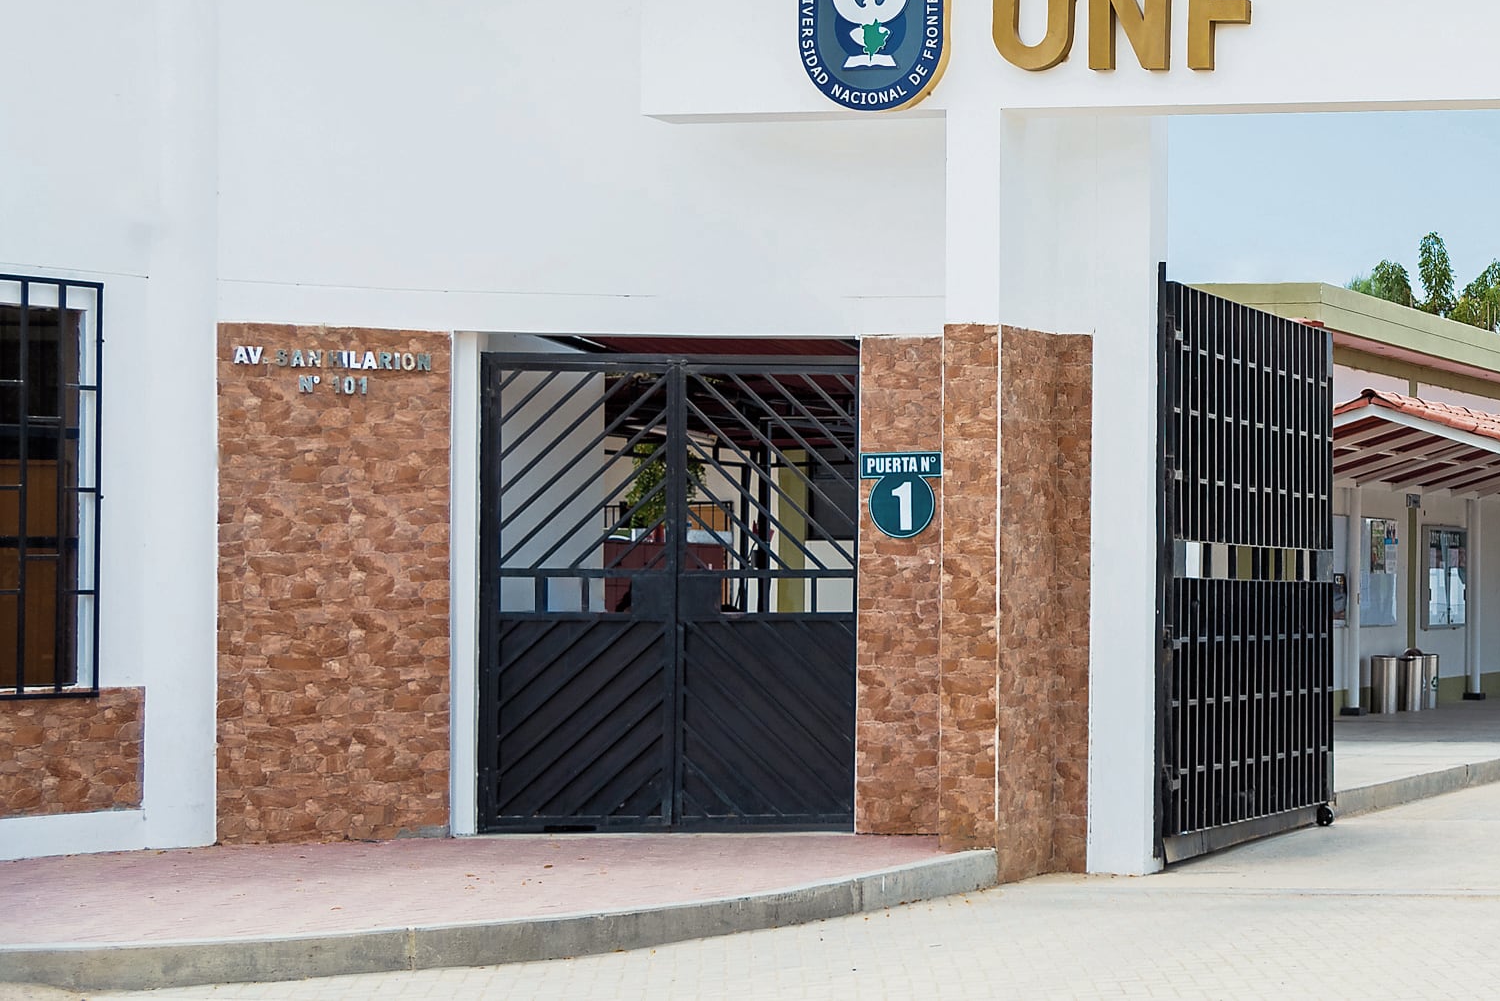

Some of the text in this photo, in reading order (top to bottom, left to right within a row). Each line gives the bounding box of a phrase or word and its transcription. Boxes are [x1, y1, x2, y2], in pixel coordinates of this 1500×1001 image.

[830, 84, 908, 105] NACIONAL
[908, 64, 928, 86] DE
[233, 345, 432, 371] AV. SAN HILARION
[332, 376, 368, 395] 101
[867, 457, 918, 473] PUERTA
[891, 481, 912, 530] 1
